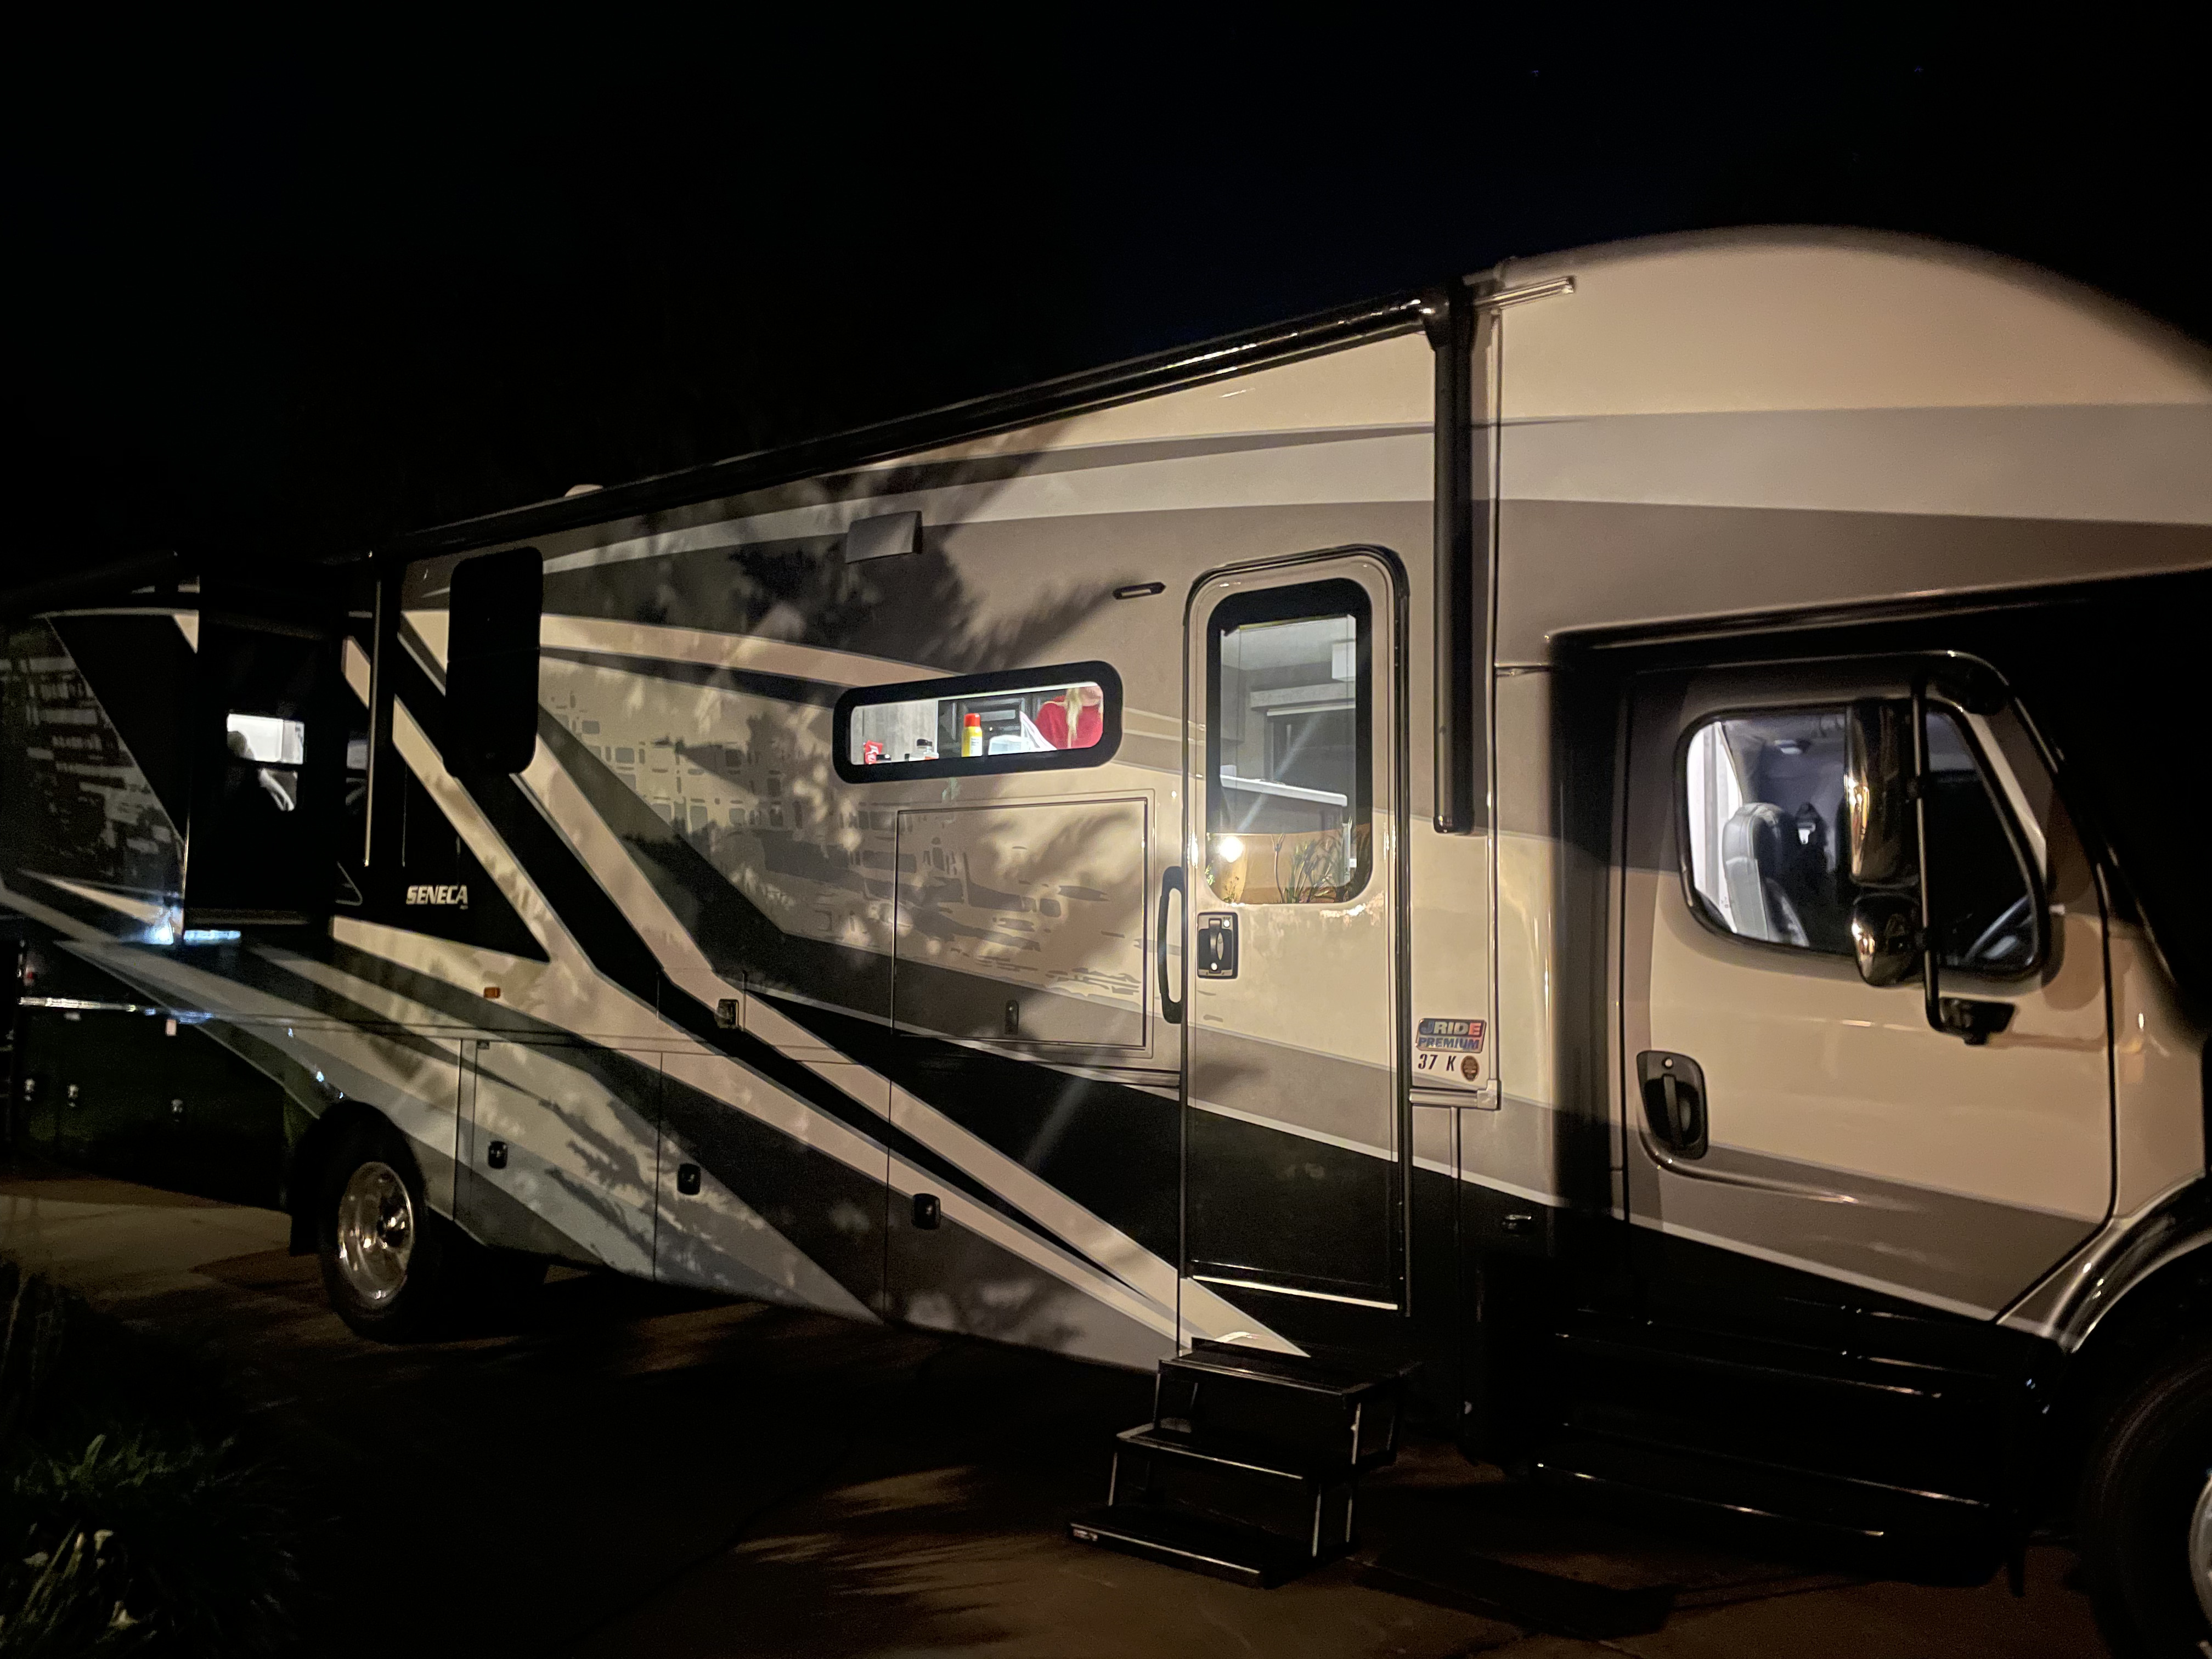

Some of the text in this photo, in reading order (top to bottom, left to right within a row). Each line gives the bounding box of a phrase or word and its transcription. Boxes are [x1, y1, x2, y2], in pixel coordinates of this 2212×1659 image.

[405, 884, 469, 905] SENECA
[1418, 1037, 1480, 1049] PREMIUM
[1418, 1053, 1438, 1070] 37
[1446, 1055, 1457, 1071] K
